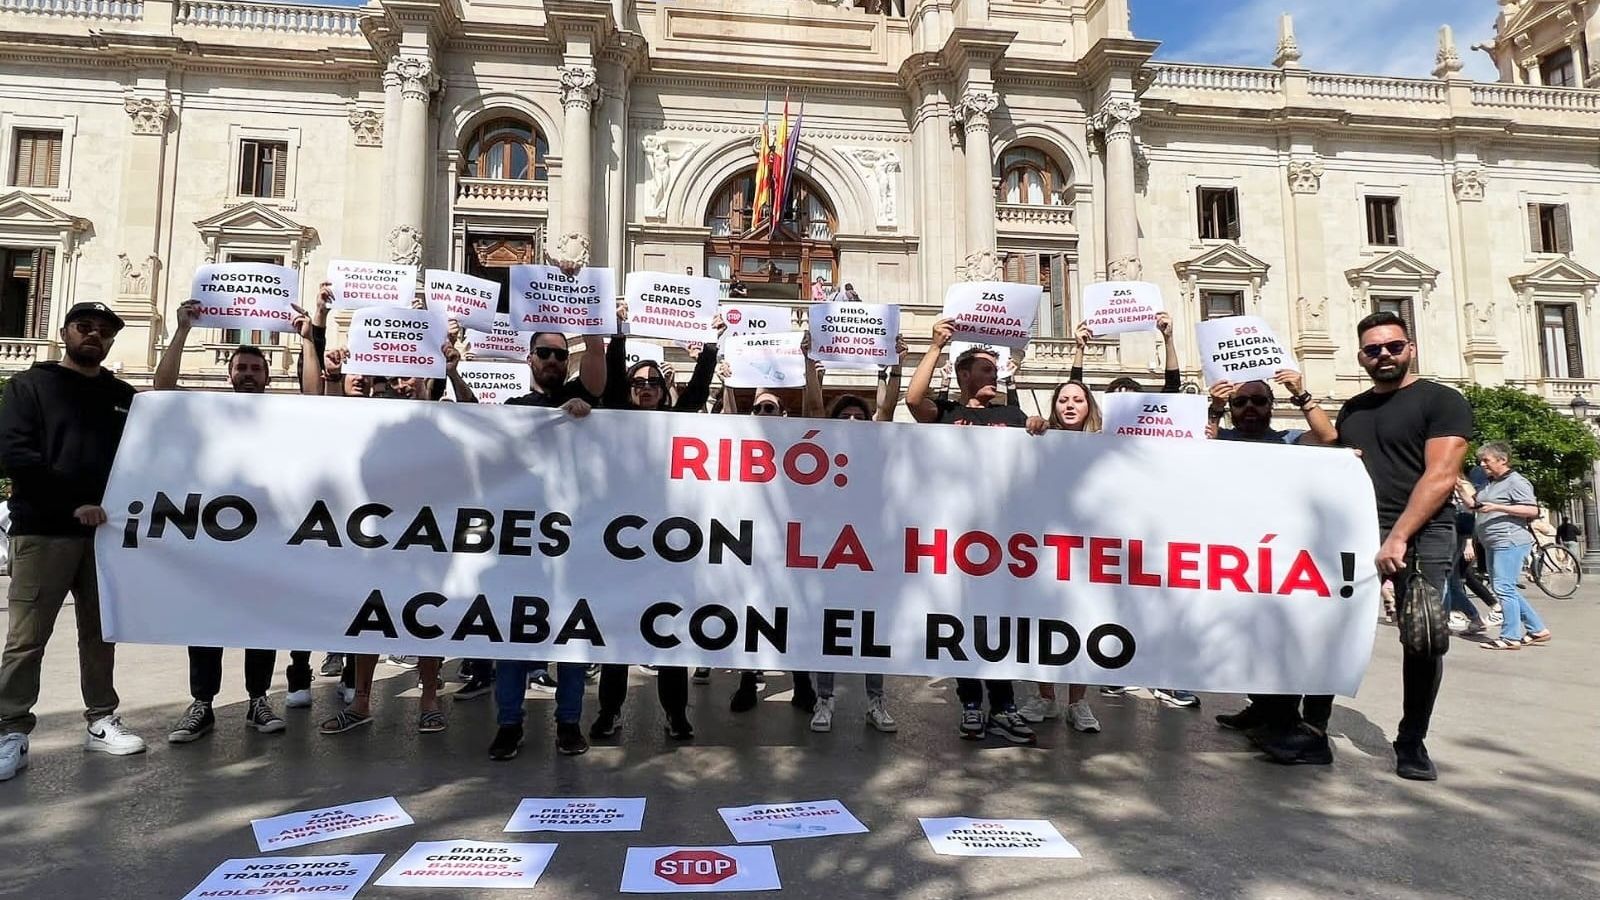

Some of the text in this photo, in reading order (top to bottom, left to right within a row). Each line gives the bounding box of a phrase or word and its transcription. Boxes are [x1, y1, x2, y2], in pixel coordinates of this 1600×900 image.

[211, 274, 281, 285] NOSOTROS
[201, 284, 290, 297] TRABAJAMOS
[345, 282, 397, 291] PROVOCA
[431, 282, 492, 300] UNA ZAS ES
[530, 281, 596, 294] QUEREMOS
[653, 283, 691, 295] BARES
[525, 291, 600, 304] SOLUCIONES
[982, 292, 1005, 302] ZAS
[1113, 289, 1132, 297] ZAS
[233, 297, 256, 305] ¡NO
[431, 293, 488, 309] UNA RUINA
[640, 293, 702, 308] CERRADOS
[1109, 298, 1136, 306] ZONA
[197, 307, 292, 320] MOLESTAMOS!
[538, 304, 588, 315] ¡NO NOS
[645, 305, 695, 319] BARRIOS
[975, 303, 1006, 314] ZONA
[1094, 305, 1153, 316] ARRUINADA
[364, 319, 429, 330] NO SOMOS
[523, 314, 603, 326] ABANDONES!
[632, 315, 708, 331] ARRUINADOS
[748, 319, 767, 328] NO
[825, 315, 883, 325] QUEREMOS
[956, 313, 1021, 327] ARRUINADA
[1088, 317, 1115, 325] PARA
[368, 330, 423, 341] LATEROS
[490, 328, 519, 336] TEROS
[821, 324, 887, 336] SOLUCIONES
[979, 326, 1027, 338] SIEMPRE
[1235, 326, 1258, 335] SOS
[485, 335, 514, 344] SOMOS
[831, 335, 875, 345] ¡NO NOS
[1218, 336, 1276, 350] PELIGRAN
[372, 342, 417, 352] SOMOS
[473, 342, 527, 353] HOSTELEROS
[818, 345, 888, 357] ABANDONES!
[355, 353, 434, 365] HOSTELEROS
[1212, 346, 1269, 362] PUESTOS
[1223, 356, 1281, 372] TRABAJO
[461, 371, 516, 380] NOSOTROS
[468, 381, 522, 390] ABAJAMOS
[479, 391, 496, 399] ¡NO
[1143, 404, 1168, 413] ZAS
[1137, 416, 1173, 425] ZONA
[1117, 426, 1193, 438] ARRUINADA
[671, 429, 849, 487] RIBÓ:
[122, 491, 1356, 599] ¡NO ACABES CON LA HOSTELERÍA!
[344, 589, 1137, 670] ACABA CON EL RUIDO
[305, 813, 355, 825] ZONA
[311, 810, 344, 819] ZAS
[268, 815, 400, 843] PARA SIEMPRE
[279, 813, 385, 836] ARRUINADA
[425, 855, 523, 863] CERRADOS
[243, 861, 351, 871] NOSOTROS
[428, 862, 509, 870] BARRIOS
[660, 859, 731, 875] STOP
[223, 869, 358, 880] TRABAJAMOS
[262, 879, 300, 888] ¡NO
[199, 885, 349, 897] MOLESTAMOS!
